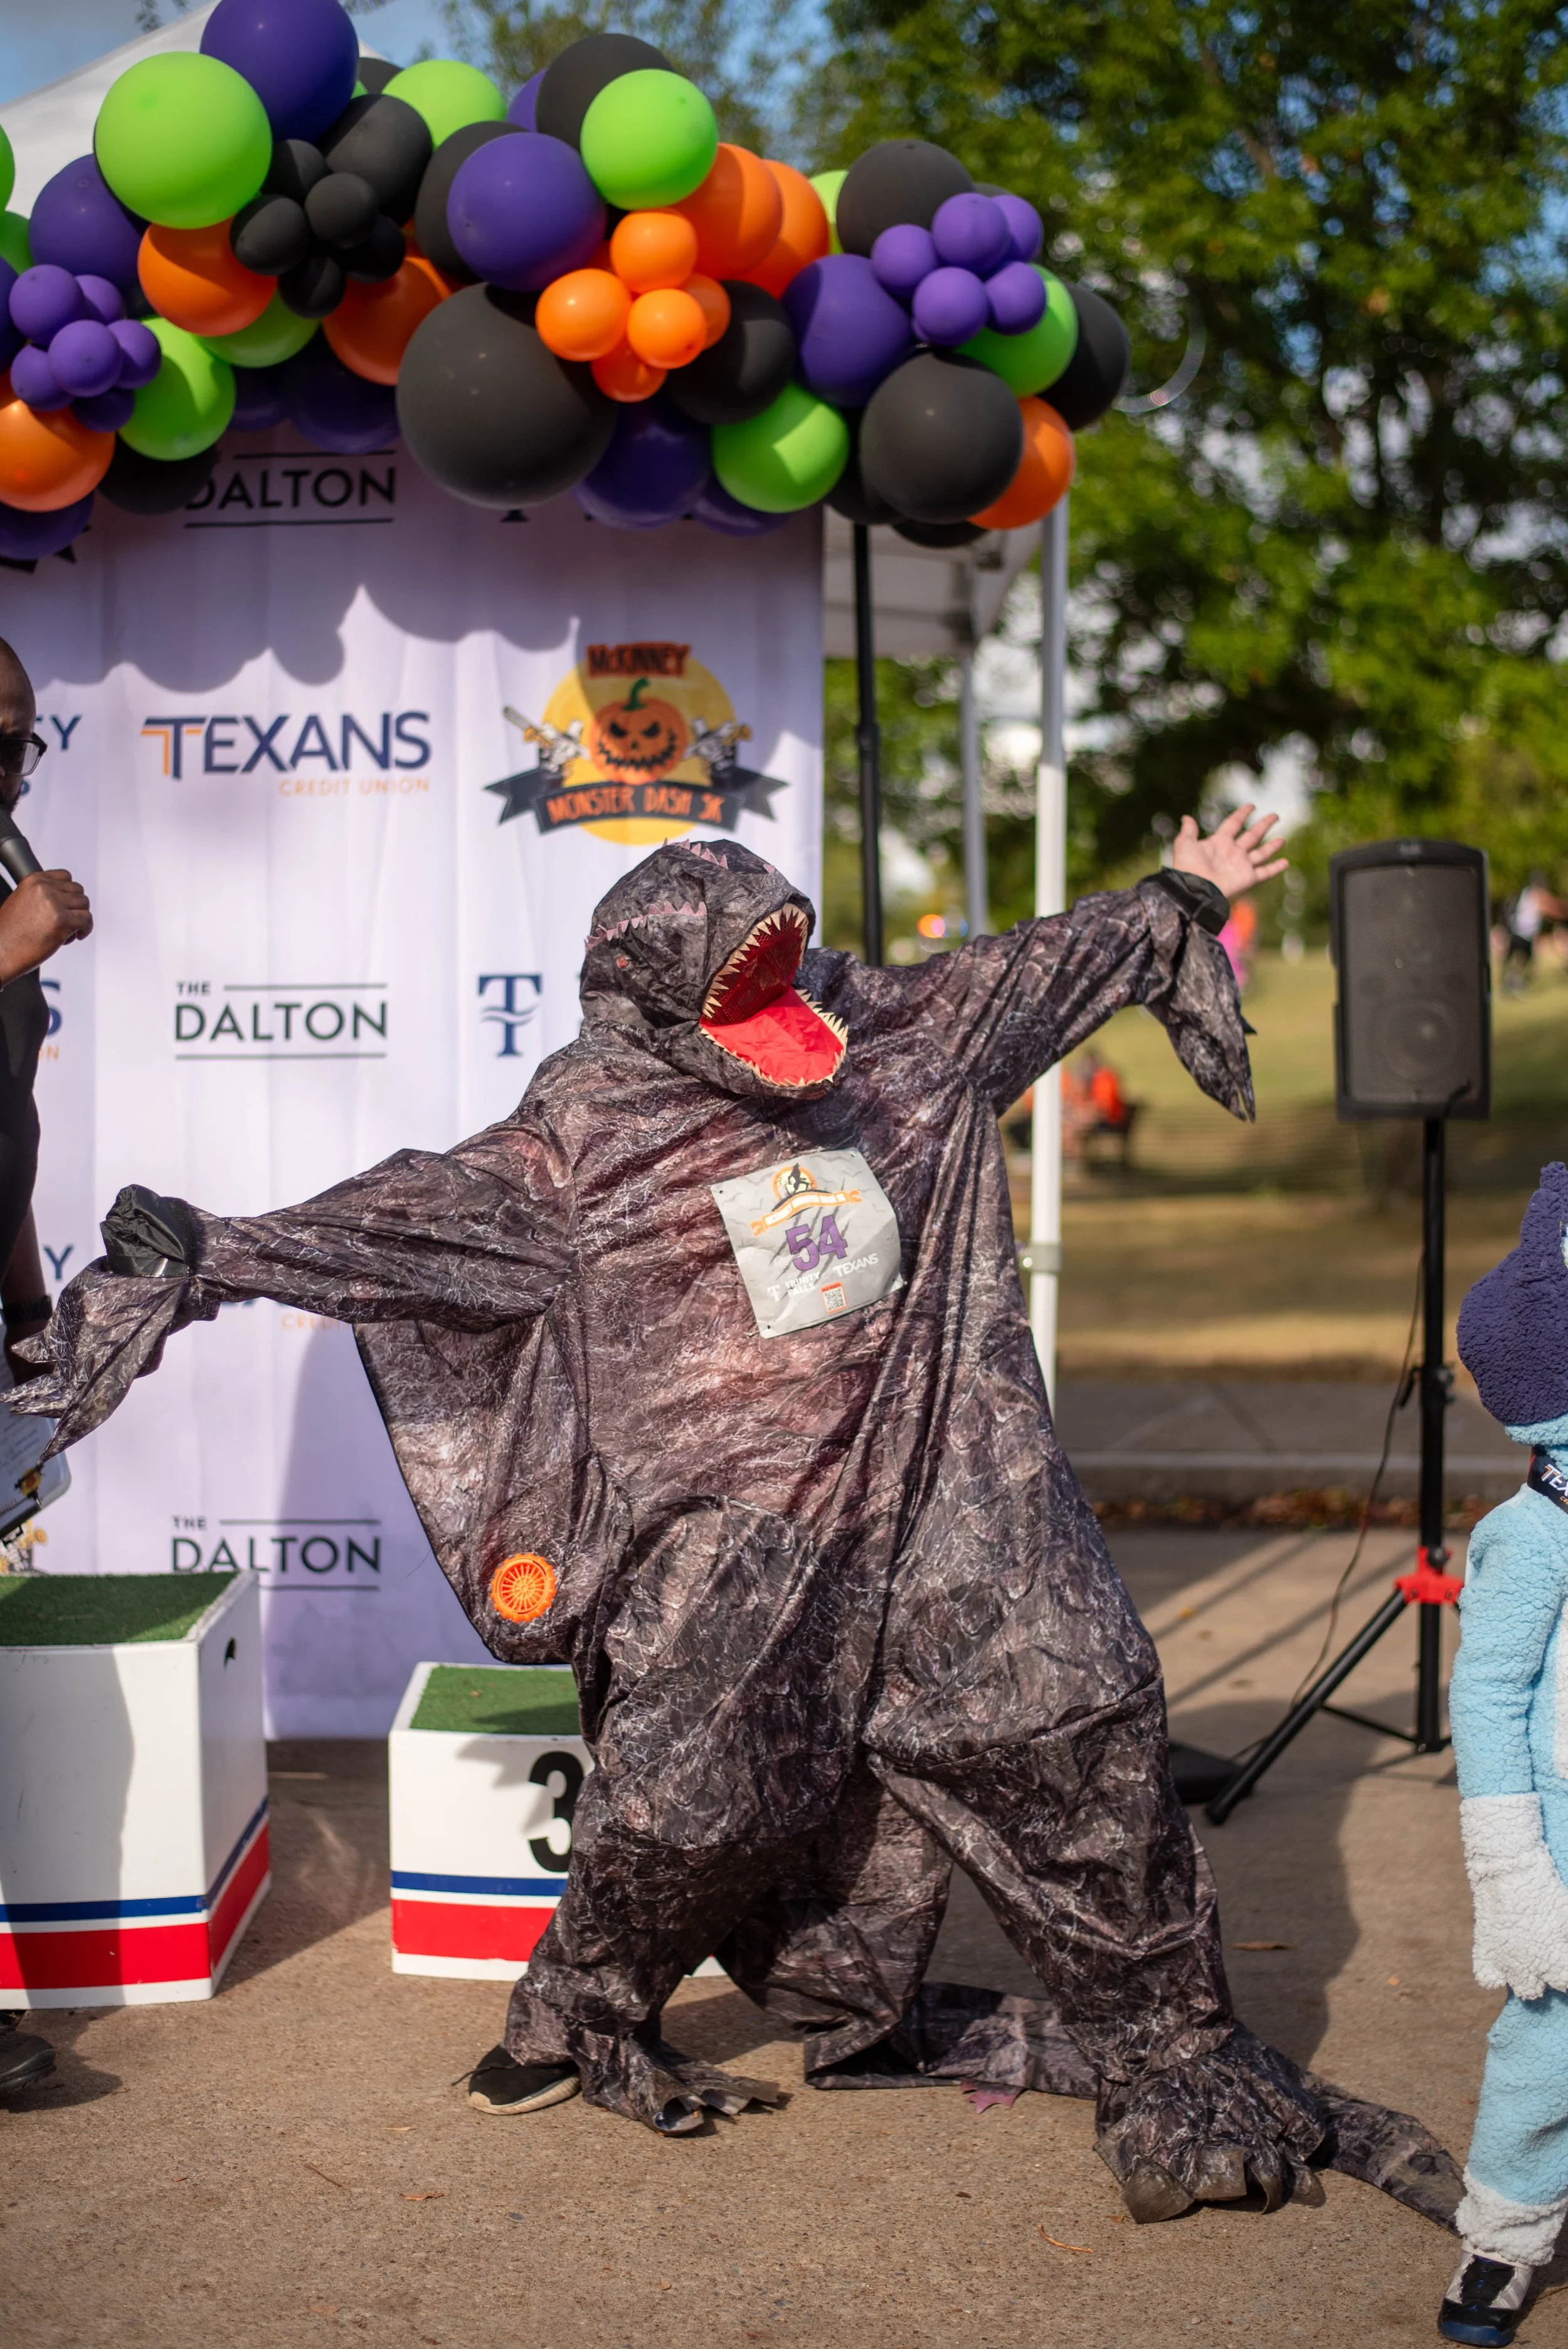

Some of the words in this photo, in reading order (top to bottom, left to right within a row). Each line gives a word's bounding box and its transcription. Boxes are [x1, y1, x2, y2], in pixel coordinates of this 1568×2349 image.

[140, 711, 431, 779] TEXANS
[278, 778, 351, 797] CREDIT
[359, 775, 430, 795] UNION
[546, 786, 635, 824] MONSTER
[644, 787, 692, 815] DASH
[177, 981, 210, 995] THE
[175, 1002, 387, 1041] DALTON
[785, 1214, 848, 1271] 54
[785, 1271, 820, 1289] TRINITY
[833, 1254, 878, 1277] TEXANS
[788, 1283, 815, 1297] FALLS
[172, 1516, 206, 1530] THE
[172, 1536, 379, 1573] DALTON
[529, 1751, 585, 1872] 3
